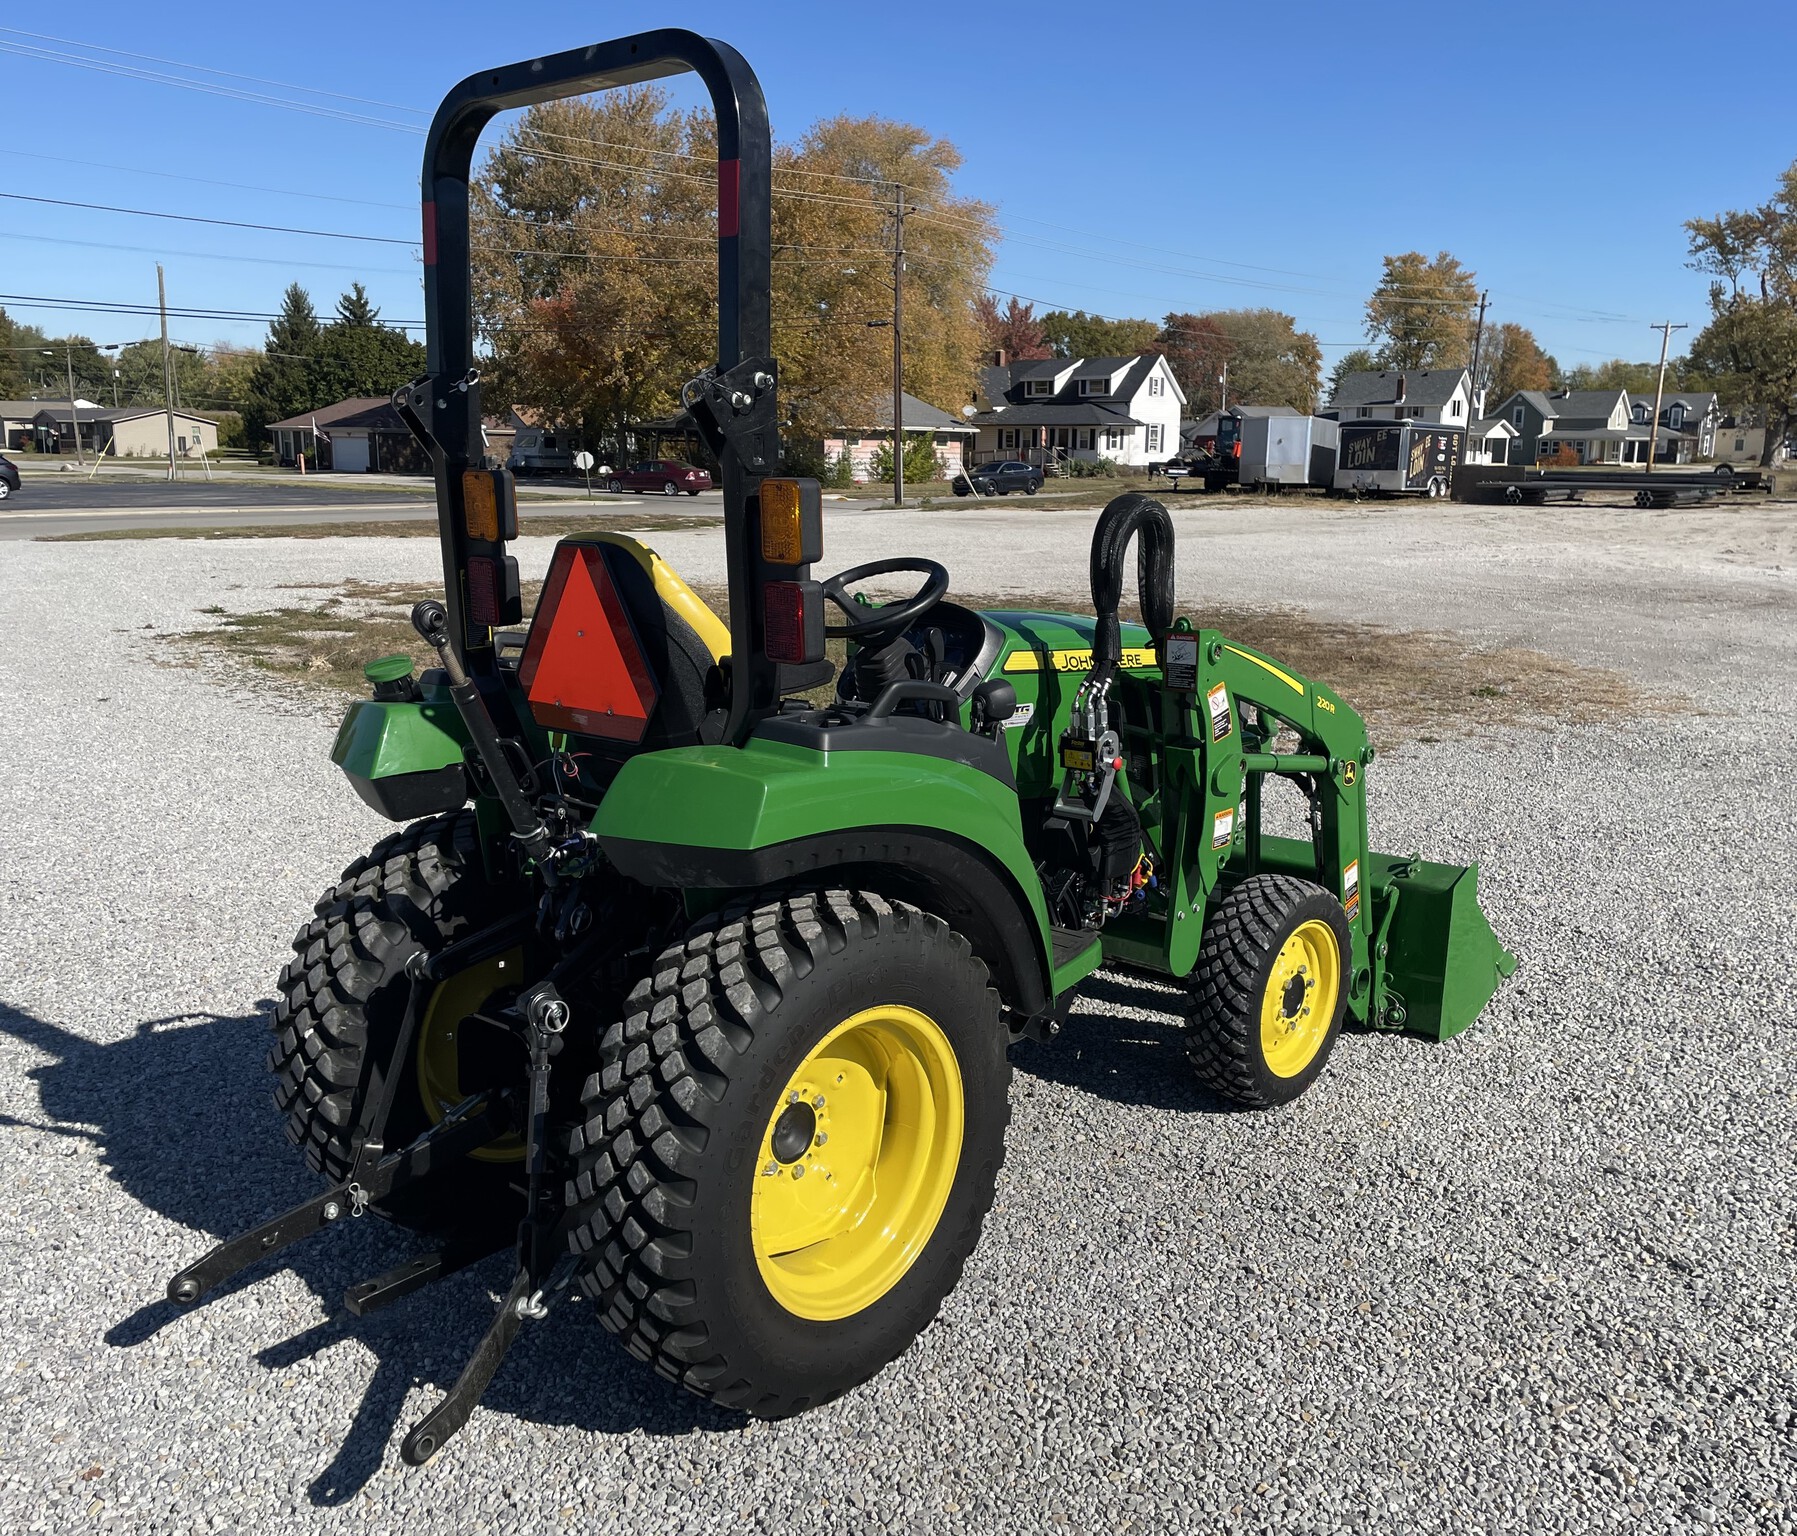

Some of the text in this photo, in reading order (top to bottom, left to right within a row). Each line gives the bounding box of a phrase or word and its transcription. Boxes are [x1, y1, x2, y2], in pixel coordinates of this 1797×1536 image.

[1347, 446, 1376, 468] LOIN
[1120, 654, 1143, 666] ERE
[1316, 695, 1336, 715] 220R
